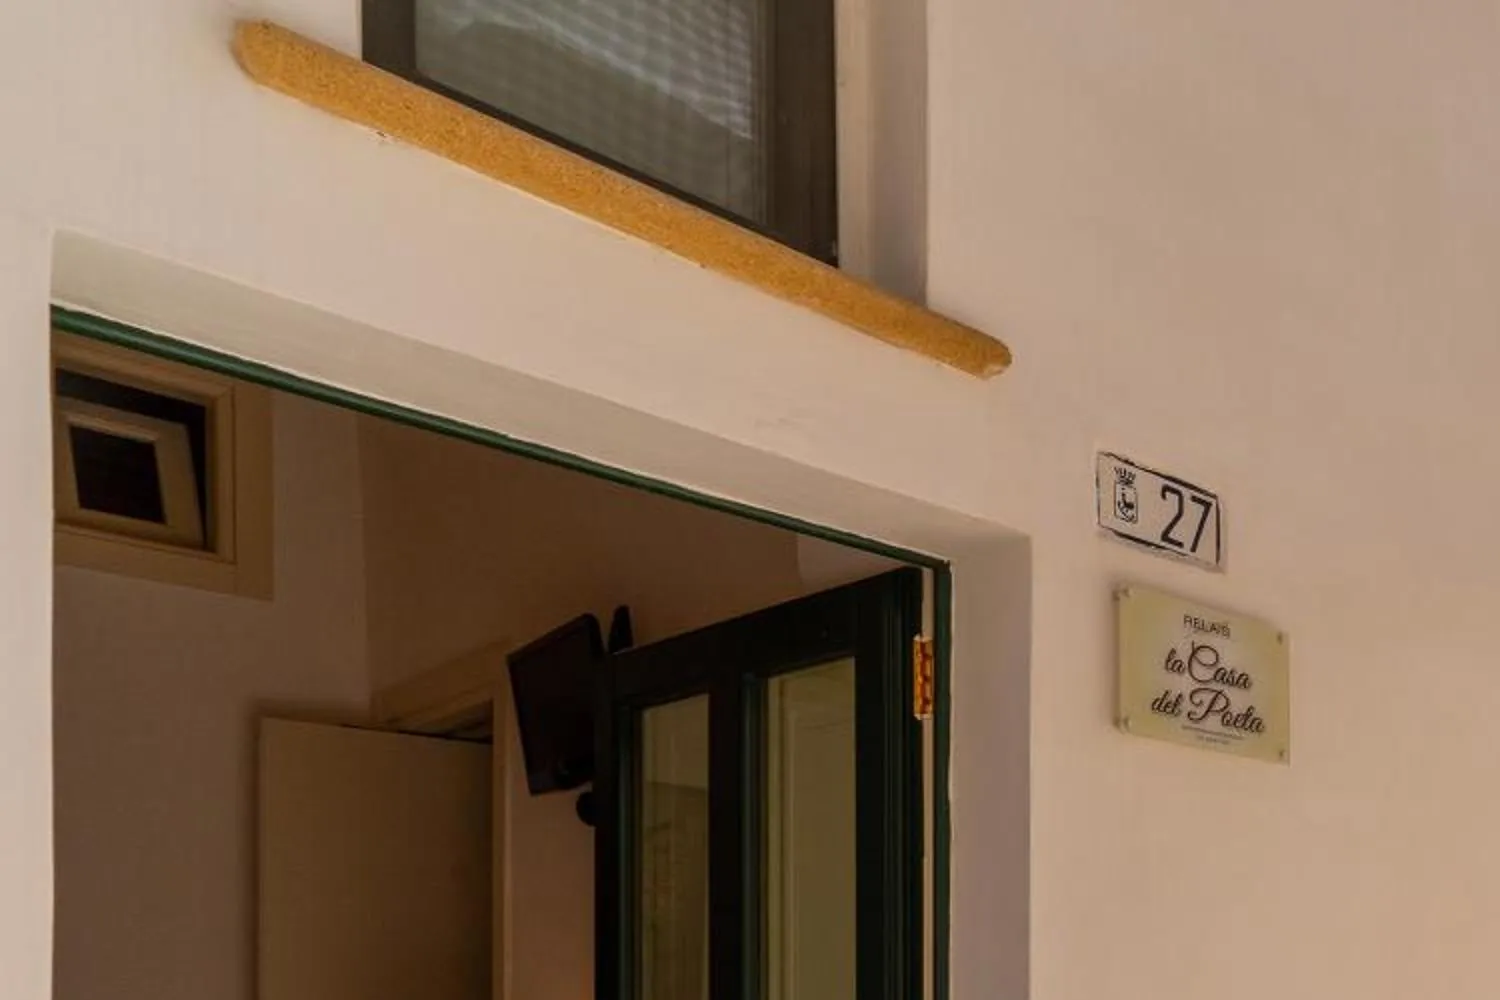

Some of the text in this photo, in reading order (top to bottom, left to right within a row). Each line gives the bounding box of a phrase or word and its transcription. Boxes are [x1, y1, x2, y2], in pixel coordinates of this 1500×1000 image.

[1160, 484, 1213, 552] 27
[1183, 614, 1230, 638] RELAIS
[1164, 640, 1252, 689] la Casa
[1151, 687, 1265, 733] del Poeta
